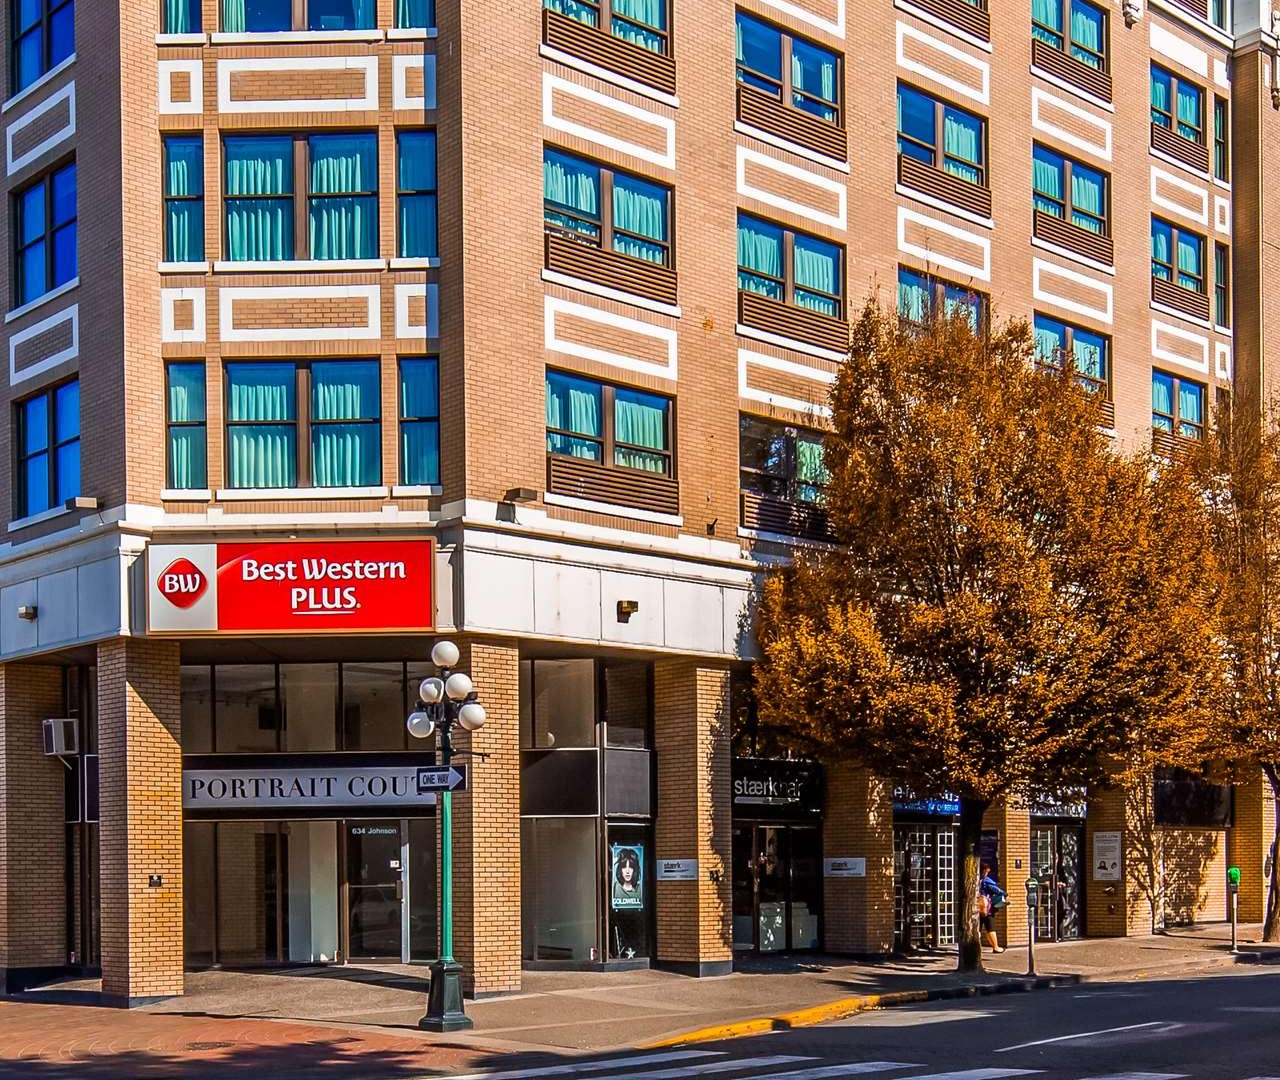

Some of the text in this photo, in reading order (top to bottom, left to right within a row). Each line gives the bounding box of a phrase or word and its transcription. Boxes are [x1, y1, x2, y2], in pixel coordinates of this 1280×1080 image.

[242, 558, 406, 580] Best Western
[164, 574, 200, 593] BW
[190, 776, 338, 799] PORTRAIT
[422, 774, 449, 785] ONE WAY
